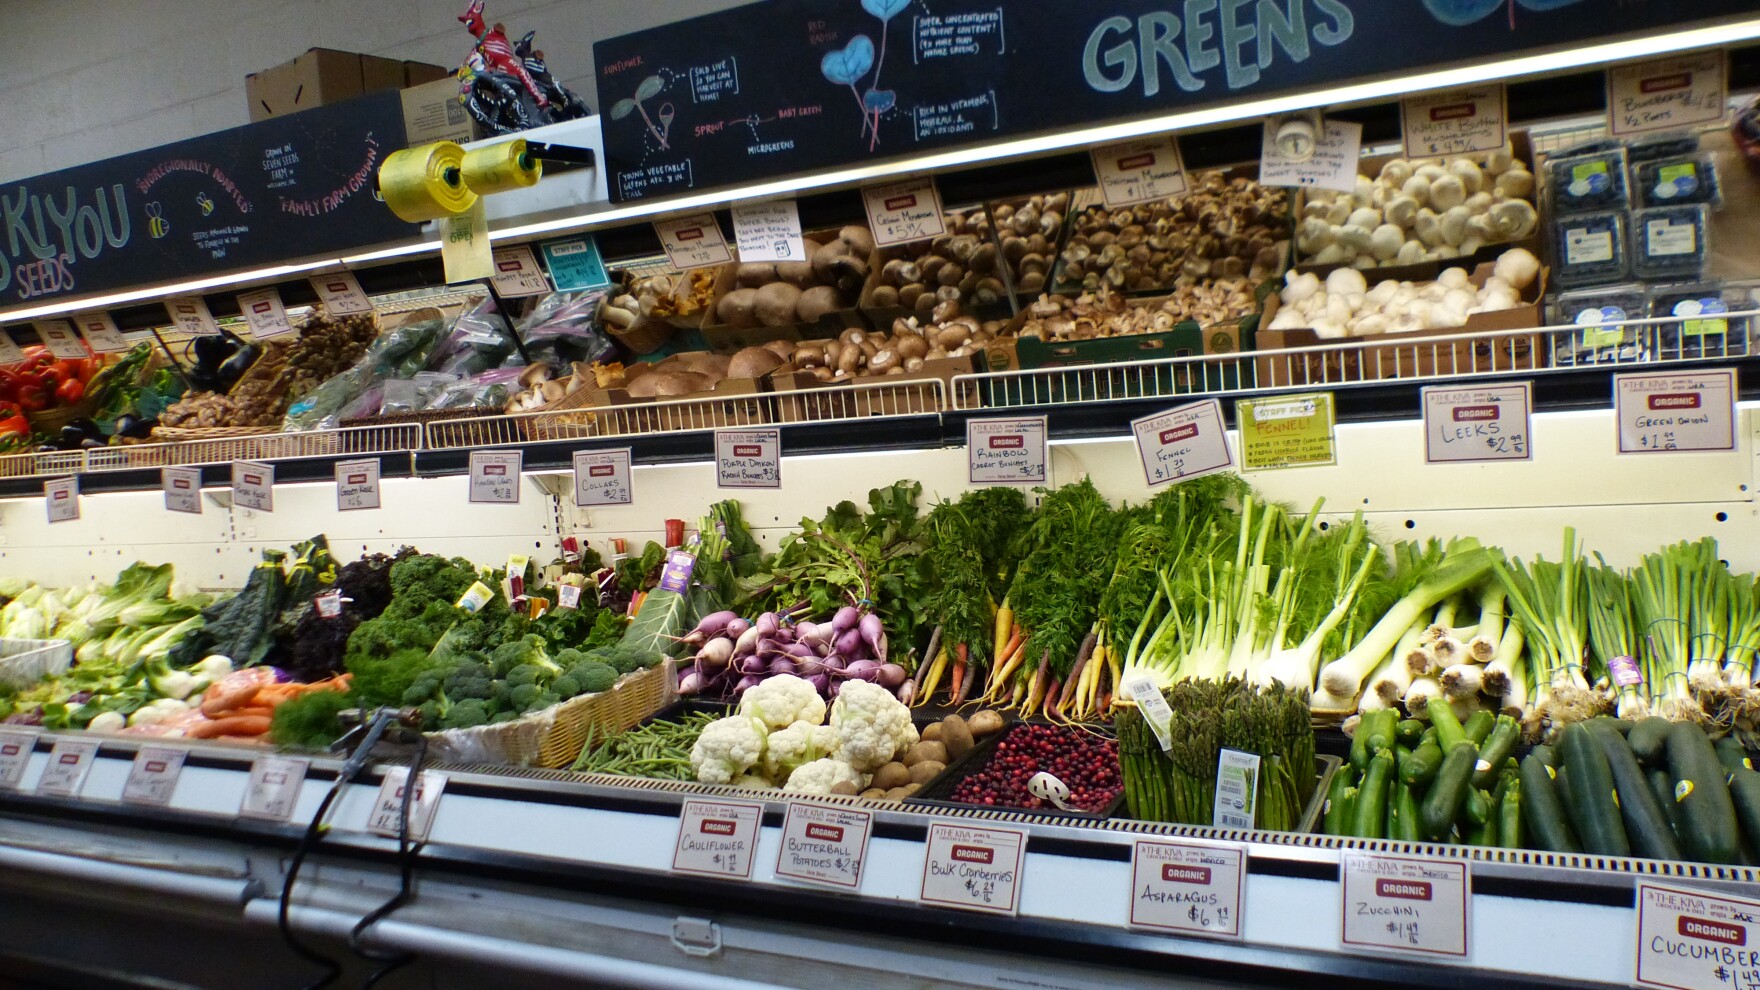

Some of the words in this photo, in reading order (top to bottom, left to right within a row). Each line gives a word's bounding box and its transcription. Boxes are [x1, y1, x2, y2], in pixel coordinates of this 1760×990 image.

[945, 13, 999, 25] CONCENTRATED
[1083, 0, 1354, 96] GREENS
[604, 55, 644, 74] SUNFLOWER
[778, 107, 797, 119] BABY
[799, 104, 822, 116] GREEN
[694, 120, 725, 138] SPROUT
[747, 139, 796, 155] MICROGREENS
[622, 170, 645, 182] YOUNG
[646, 162, 687, 176] VEGETABLE
[281, 200, 320, 217] FAMILY
[322, 184, 352, 214] FARM
[0, 184, 130, 292] KIYOU
[16, 253, 75, 299] SEEDS
[1654, 396, 1695, 407] ORGANIC
[1457, 409, 1494, 418] ORGANIC
[1635, 415, 1673, 428] GREEN
[1677, 413, 1709, 426] ONION
[1256, 416, 1310, 435] FENNEL!
[1441, 422, 1500, 443] LEEKS
[1164, 427, 1194, 441] ORGANIC
[993, 438, 1020, 446] ORGANIC
[976, 447, 1028, 459] RAINBOW
[1156, 448, 1191, 462] FENNEL
[720, 458, 747, 468] PURPLE
[581, 479, 620, 492] COLLARS
[704, 822, 732, 832] ORGANIC
[810, 827, 839, 839] ORGANIC
[940, 828, 953, 837] THE
[954, 830, 971, 839] KIVA
[681, 833, 745, 851] CAULIFLOWER
[788, 837, 851, 856] BUTTERBALL
[956, 849, 989, 860] ORGANIC
[1147, 846, 1161, 855] THE
[1164, 847, 1183, 857] KIVA
[790, 852, 832, 868] POTATOES
[1377, 861, 1399, 871] KIVA
[1167, 868, 1206, 881] ORGANIC
[1140, 884, 1218, 905] ASPARAGUS
[1382, 883, 1426, 897] ORGANIC
[1655, 892, 1677, 905] THE
[1680, 896, 1706, 910] KIVA
[1356, 901, 1420, 918] ZUCCHINI
[1686, 922, 1738, 940] ORGANIC
